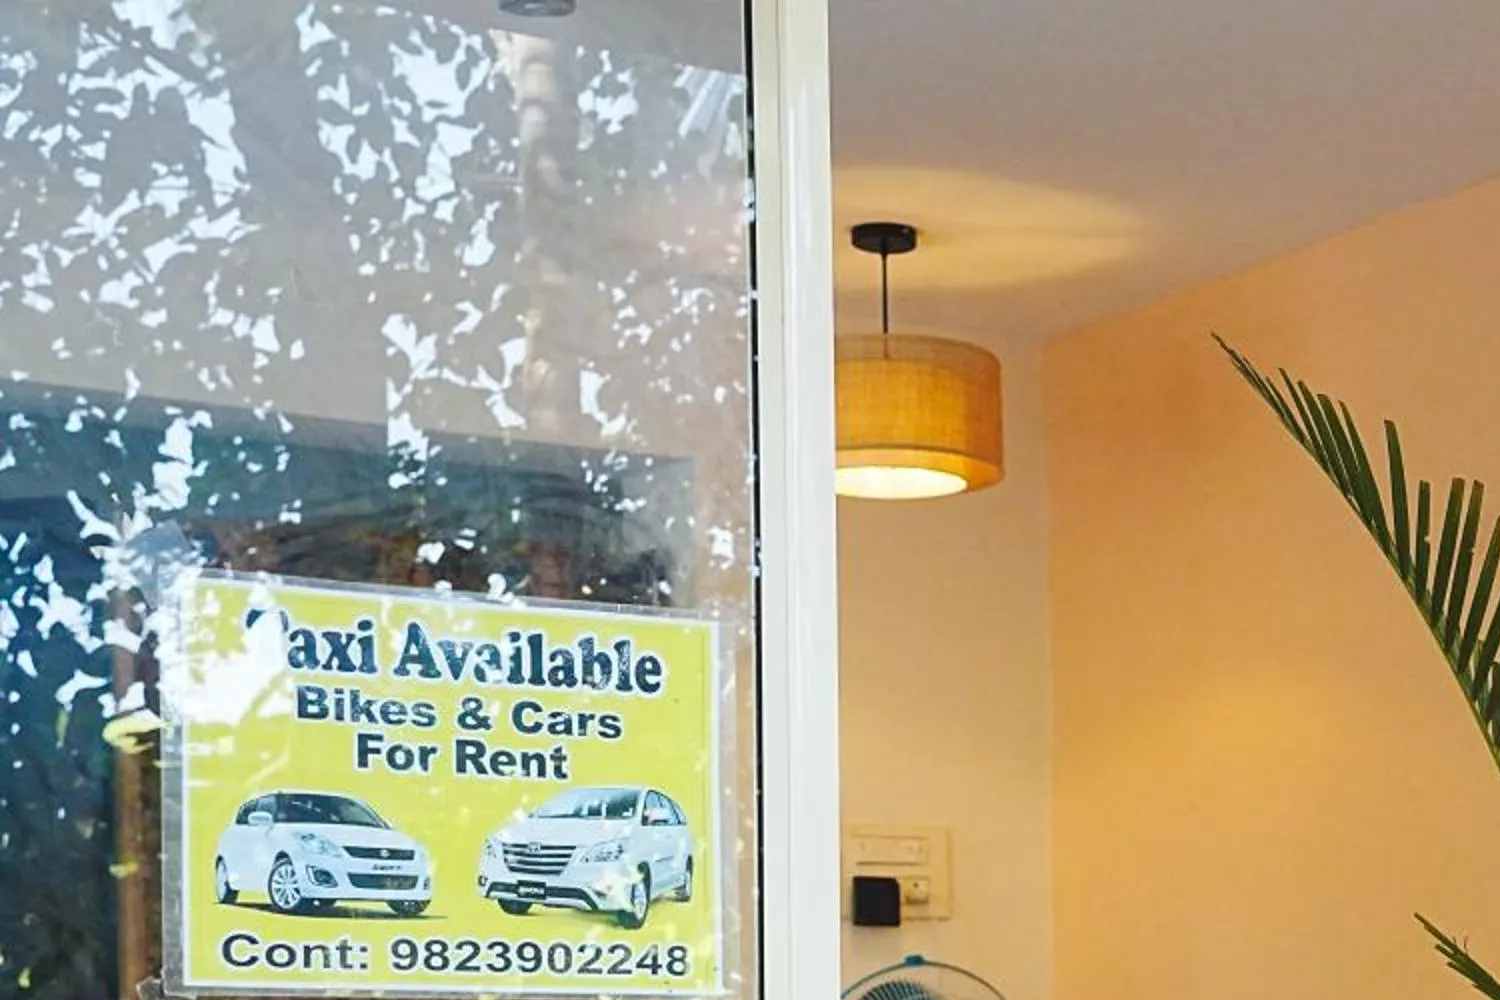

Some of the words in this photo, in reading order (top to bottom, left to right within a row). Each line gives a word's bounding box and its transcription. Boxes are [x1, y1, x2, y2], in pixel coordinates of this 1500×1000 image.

[246, 608, 378, 675] axi
[393, 621, 664, 694] Available
[296, 685, 438, 728] Bikes
[457, 696, 493, 731] &
[511, 701, 623, 739] Cars
[356, 733, 438, 772] For
[454, 739, 570, 780] Rent
[221, 933, 370, 969] Cont:
[390, 938, 689, 977] 9823902248
